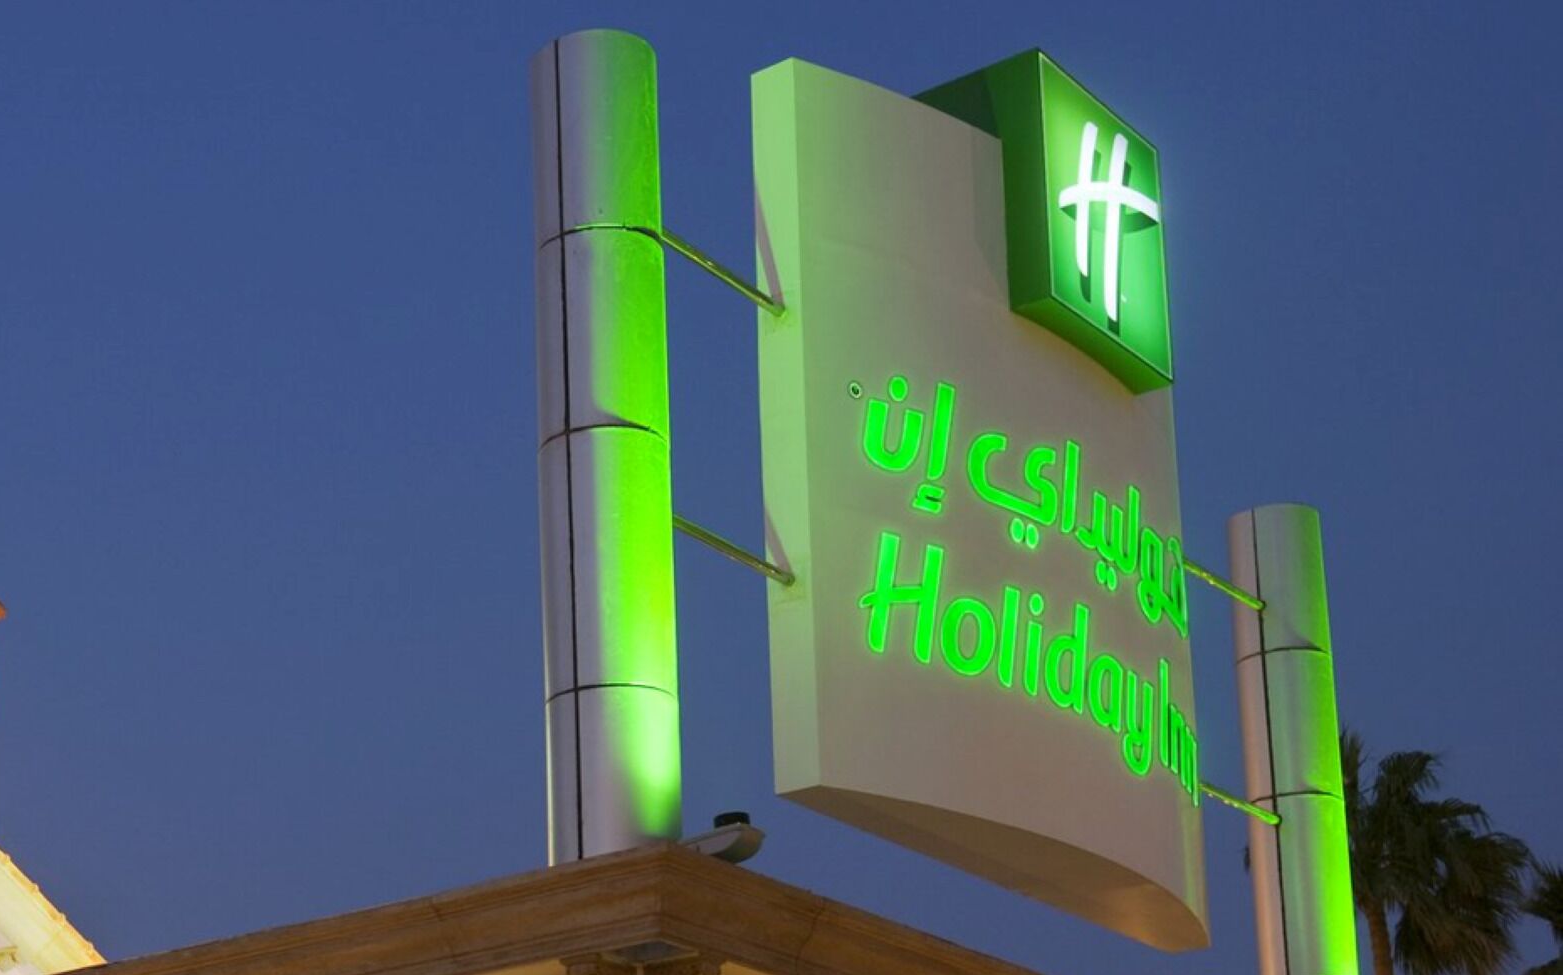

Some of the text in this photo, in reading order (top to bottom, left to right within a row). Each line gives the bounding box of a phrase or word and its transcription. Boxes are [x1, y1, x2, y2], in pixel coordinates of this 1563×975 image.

[1058, 121, 1159, 322] H
[863, 376, 955, 513] إن
[859, 531, 1151, 775] Holiday
